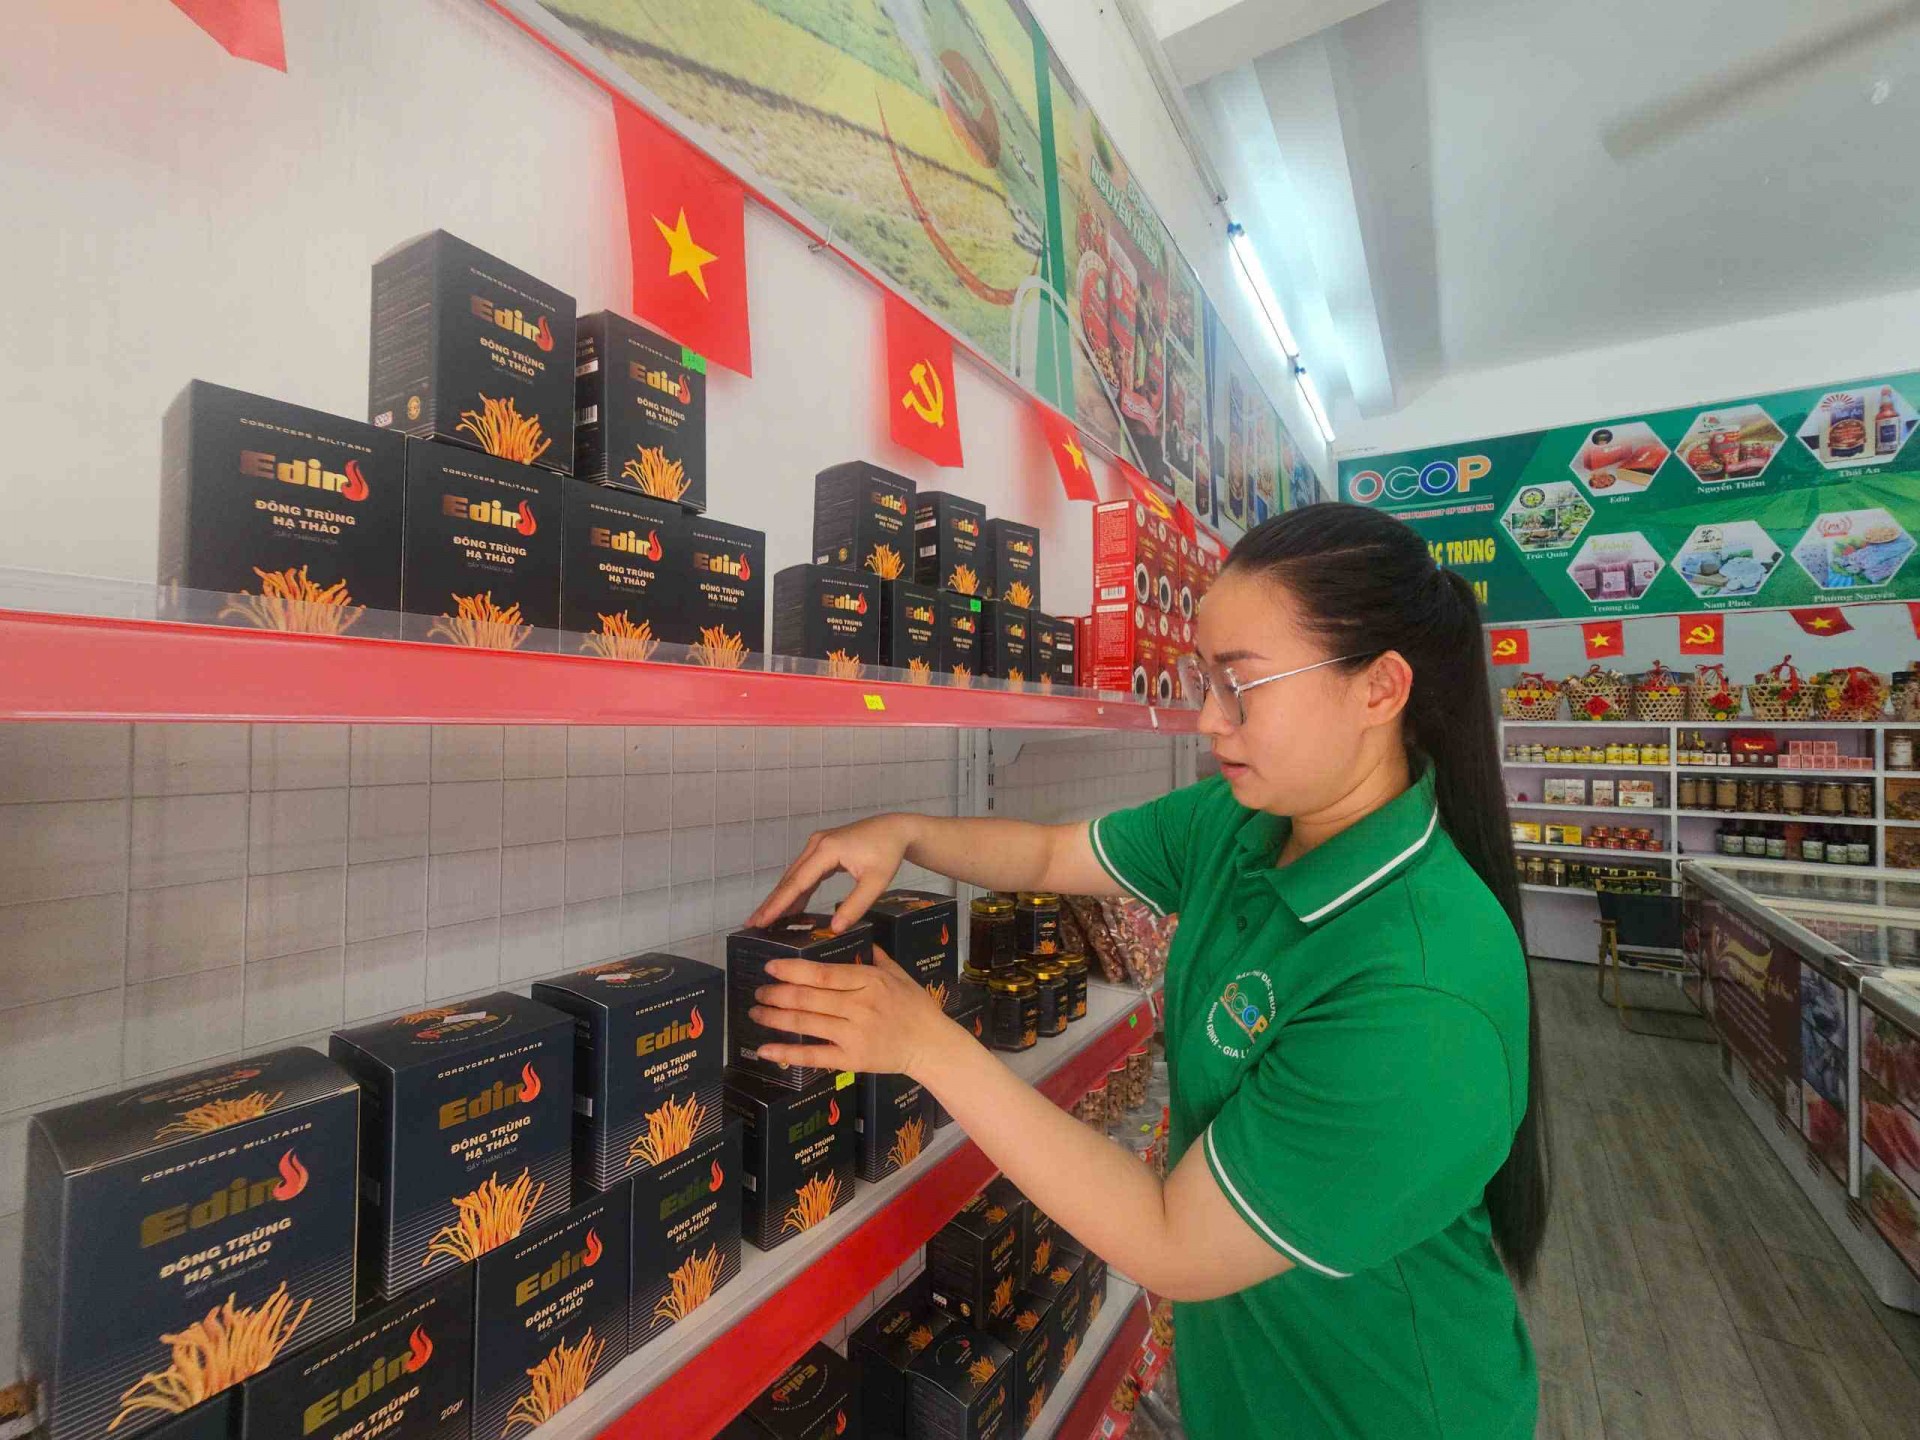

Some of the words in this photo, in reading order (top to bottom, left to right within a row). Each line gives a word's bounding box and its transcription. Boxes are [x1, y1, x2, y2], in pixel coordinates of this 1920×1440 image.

[470, 294, 541, 342] Edin
[480, 336, 510, 357] ĐÔNG
[512, 350, 546, 371] TRÙNG
[491, 352, 506, 367] HẠ
[509, 359, 535, 377] THẢO
[630, 361, 681, 397] Edin
[240, 450, 348, 493] Edin
[1349, 455, 1492, 503] OCOP
[255, 500, 301, 516] ĐÔNG
[305, 508, 356, 525] TRÙNG
[273, 515, 295, 530] HẠ
[299, 520, 341, 535] THẢO
[442, 494, 521, 529] Edin
[453, 536, 486, 549] ĐÔNG
[489, 541, 527, 557] TRÙNG
[466, 550, 482, 561] HẠ
[485, 552, 515, 565] THẢO
[590, 527, 651, 556] Edin
[599, 563, 624, 575] ĐÔNG
[626, 567, 655, 580] TRÙNG
[609, 574, 622, 584] HẠ
[623, 576, 647, 587] THẢO
[694, 552, 741, 576] Edin
[822, 593, 860, 611] Edin
[636, 1020, 691, 1057] Edin
[437, 1056, 495, 1079] CORDYCEPS
[499, 1041, 543, 1060] MILITARIS
[644, 1061, 669, 1078] ĐÔNG
[670, 1050, 698, 1070] TRÙNG
[653, 1070, 667, 1084] HẠ
[666, 1063, 689, 1080] THẢO
[439, 1080, 524, 1130] Edin
[141, 1147, 238, 1183] CORDYCEPS
[243, 1122, 313, 1150] MILITARIS
[450, 1133, 488, 1154] ĐÔNG
[490, 1116, 531, 1138] TRÙNG
[465, 1147, 483, 1162] HẠ
[486, 1133, 519, 1152] THẢO
[141, 1176, 284, 1249] Edin
[666, 1219, 691, 1239] ĐÔNG
[691, 1202, 718, 1223] TRÙNG
[676, 1231, 687, 1243] HẠ
[690, 1216, 710, 1234] THẢO
[160, 1245, 221, 1279] ĐÔNG
[226, 1217, 292, 1251] TRÙNG
[183, 1265, 213, 1286] HẠ
[218, 1241, 272, 1270] THẢO
[515, 1250, 590, 1308] Edin
[525, 1301, 557, 1328] ĐÔNG
[559, 1278, 594, 1307] TRÙNG
[537, 1316, 554, 1333] HẠ
[555, 1297, 584, 1320] THẢO
[303, 1331, 377, 1376] CORDYCEPS
[382, 1297, 437, 1331] MILITARIS
[303, 1350, 415, 1436] Edin
[368, 1386, 420, 1424] TRÙNG
